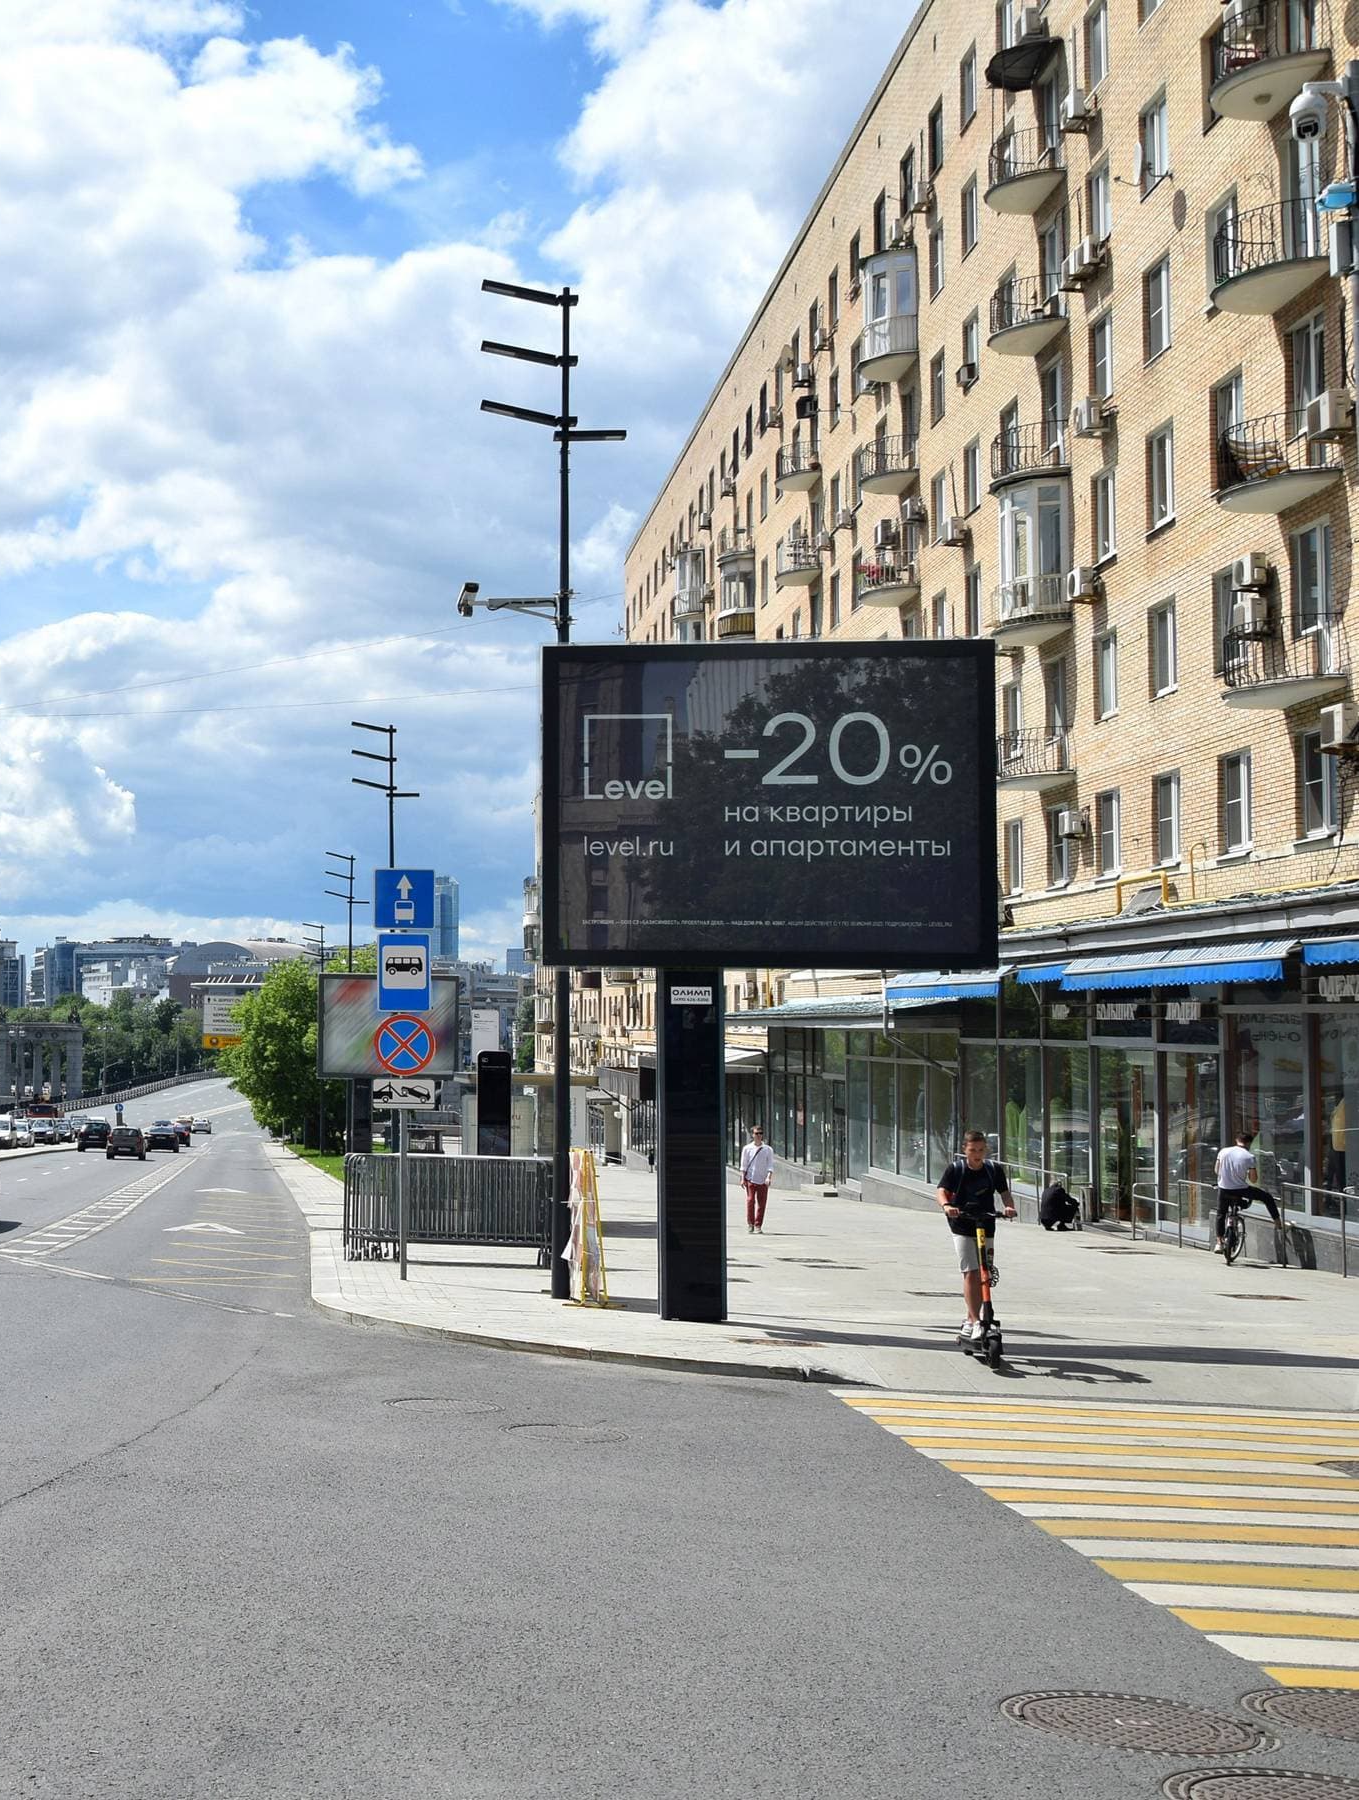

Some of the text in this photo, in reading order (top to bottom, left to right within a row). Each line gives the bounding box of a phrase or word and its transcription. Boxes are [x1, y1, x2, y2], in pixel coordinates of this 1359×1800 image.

[724, 711, 953, 786] -20%
[584, 768, 673, 800] Level
[725, 805, 912, 828] на квартиры
[584, 836, 674, 857] level.ru
[725, 839, 951, 864] и апартаменты
[672, 989, 711, 997] ОЛИМП
